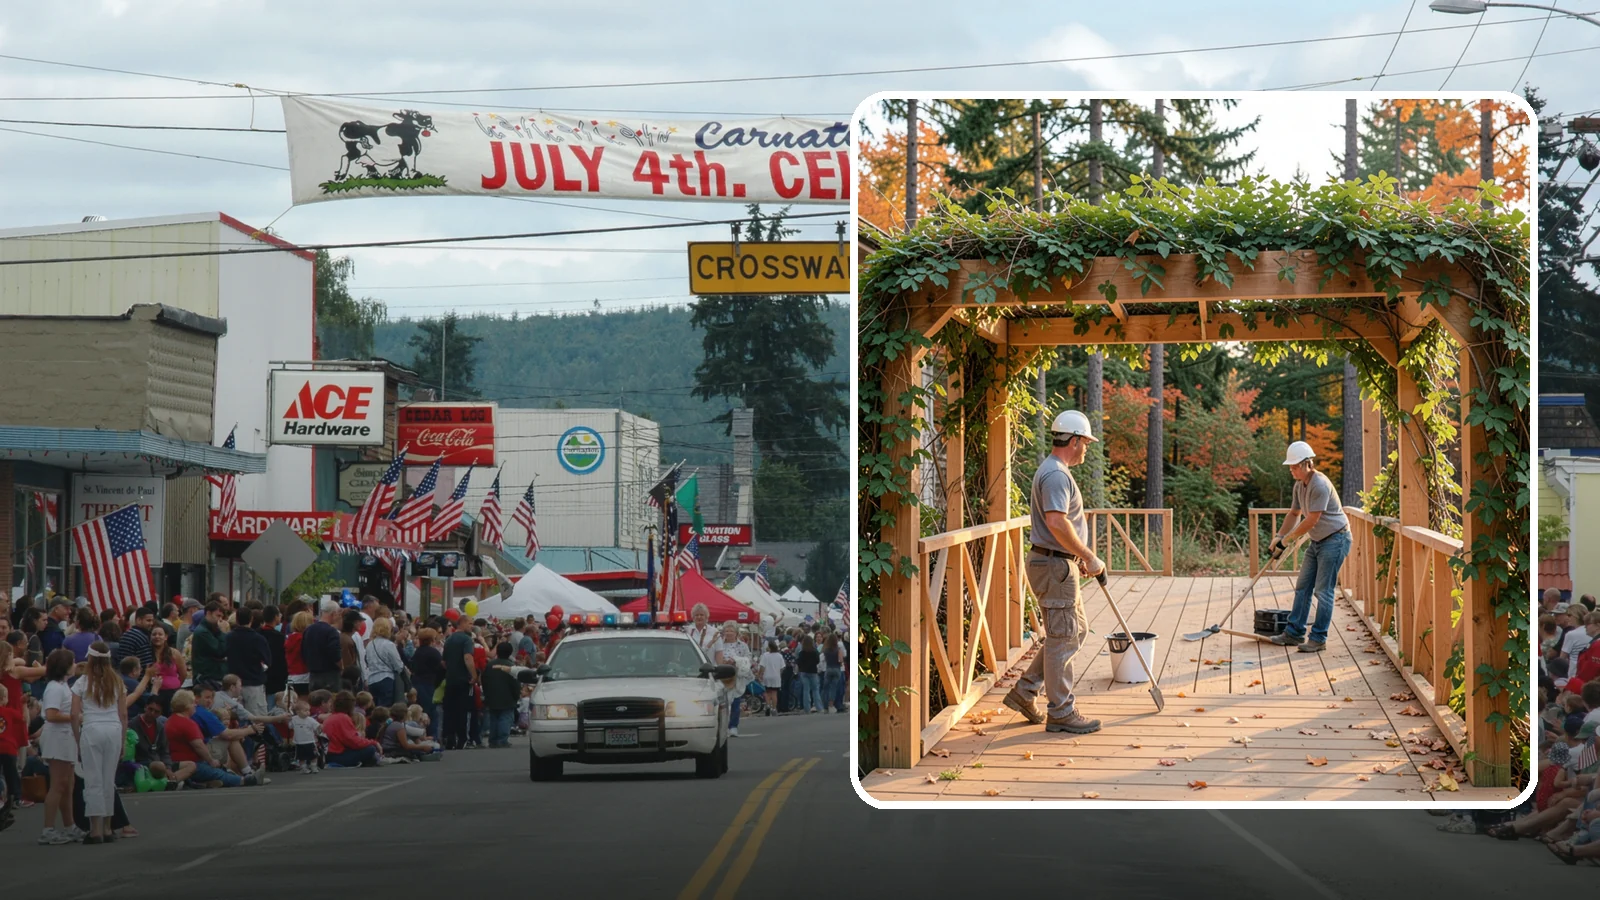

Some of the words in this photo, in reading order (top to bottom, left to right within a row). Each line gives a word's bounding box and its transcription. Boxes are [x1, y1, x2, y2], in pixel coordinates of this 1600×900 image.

[695, 121, 850, 149] Carnat
[481, 141, 605, 192] JULY
[632, 150, 746, 197] 4th.
[697, 254, 850, 280] CROSSWA
[282, 380, 373, 420] ACE
[405, 409, 452, 421] CEDAR
[283, 421, 371, 436] Hardware
[353, 467, 385, 480] Simpl
[96, 485, 124, 495] Vincent
[126, 486, 136, 495] de
[137, 486, 155, 495] Paul
[81, 503, 154, 522] THRT
[688, 527, 741, 535] CRNATION
